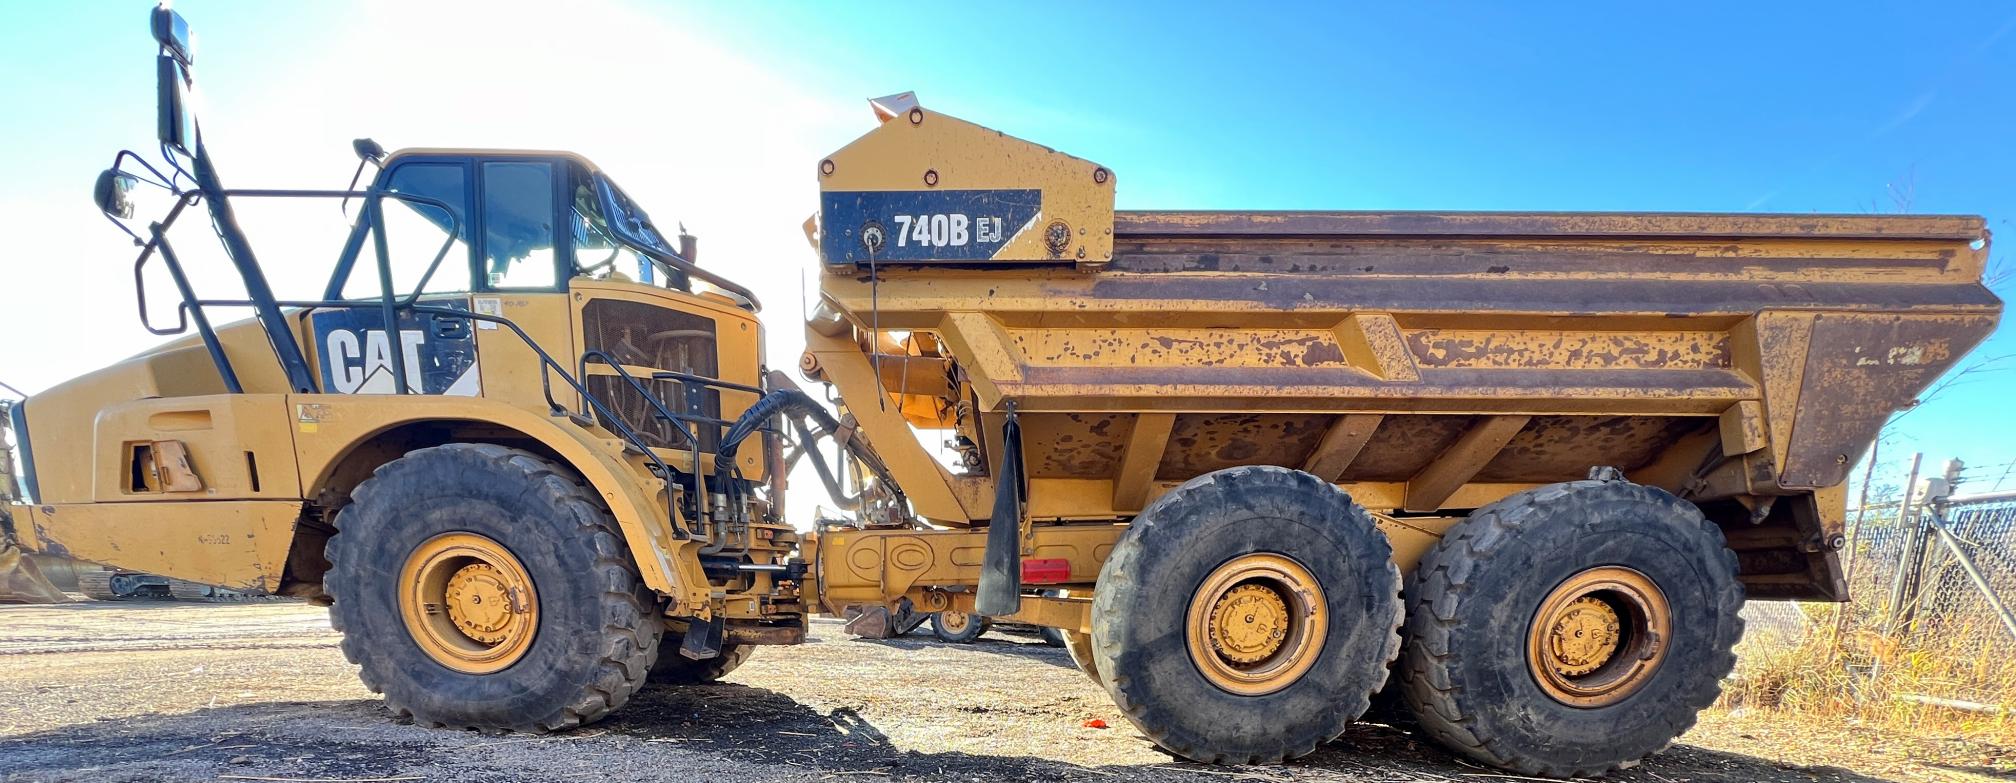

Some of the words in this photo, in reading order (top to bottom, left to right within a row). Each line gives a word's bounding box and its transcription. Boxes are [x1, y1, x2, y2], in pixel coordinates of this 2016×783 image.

[894, 214, 968, 246] 740B
[976, 217, 1001, 242] EJ
[327, 329, 424, 394] CAT
